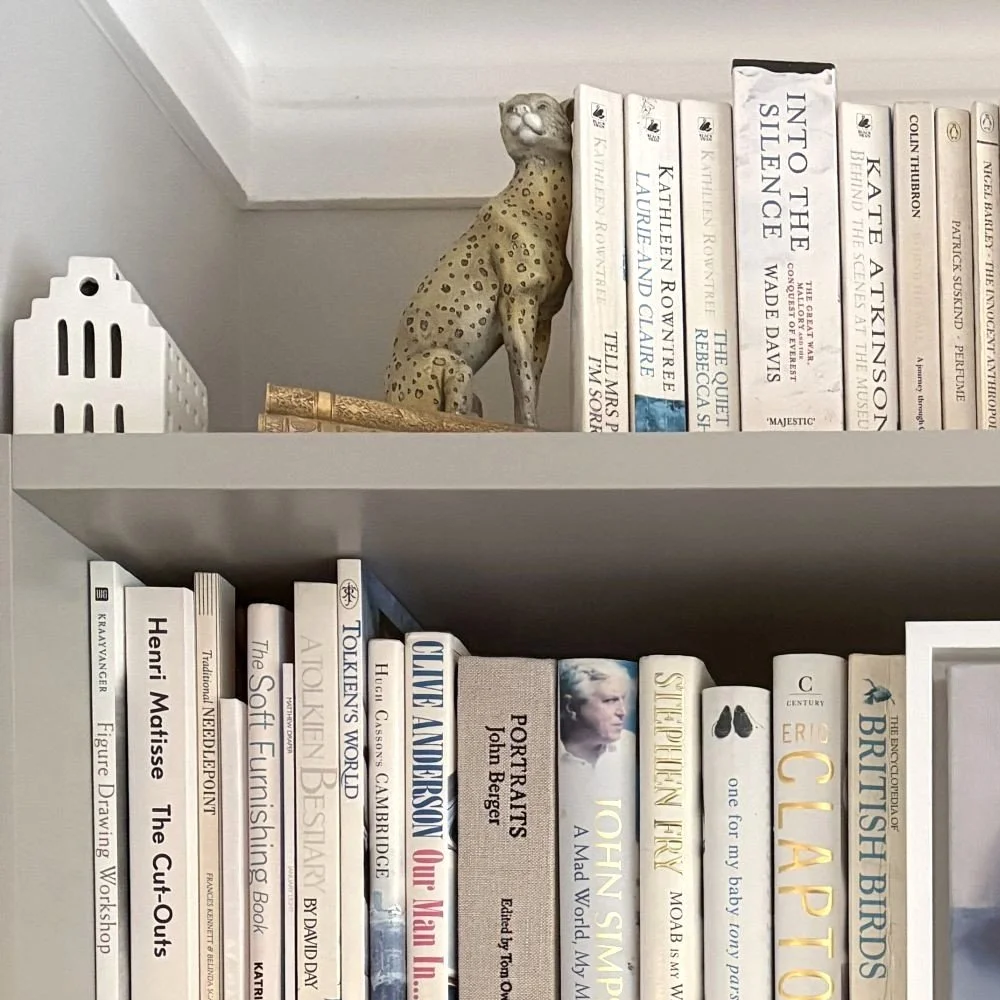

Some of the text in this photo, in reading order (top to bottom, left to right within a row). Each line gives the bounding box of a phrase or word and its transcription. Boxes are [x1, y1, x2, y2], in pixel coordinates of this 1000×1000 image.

[759, 103, 782, 240] SILENCE
[786, 92, 809, 252] INTO THE
[909, 114, 921, 218] COLIN THUBRON
[636, 171, 654, 378] LAURIE AND CLAIRE
[658, 165, 675, 392] KATHLEEN ROWNTREE
[763, 264, 781, 383] WADE DAVIS
[787, 262, 798, 382] CONQUEST OF EVEREST
[952, 220, 965, 402] PATRICK SUSKIND PERFUME
[202, 650, 215, 815] Traditional NEEDLEPOINT
[341, 620, 361, 799] TOLKIEN'S WORLD
[92, 613, 116, 954] KRAAYVANGER Figure Drawing Workshop
[148, 617, 172, 958] Henri Matisse The Cut-Outs
[412, 641, 444, 1000] CLIVE ANDERSON Our Man In...
[484, 726, 505, 826] John Berger
[509, 714, 527, 838] PORTRAITS
[595, 799, 622, 899] JOHN
[858, 714, 887, 980] BRITISH BIRDS
[303, 898, 319, 990] BY DAVID DAY
[670, 891, 683, 942] MOAB
[670, 949, 679, 958] IS
[670, 962, 679, 978] MY
[726, 924, 741, 959] tony
